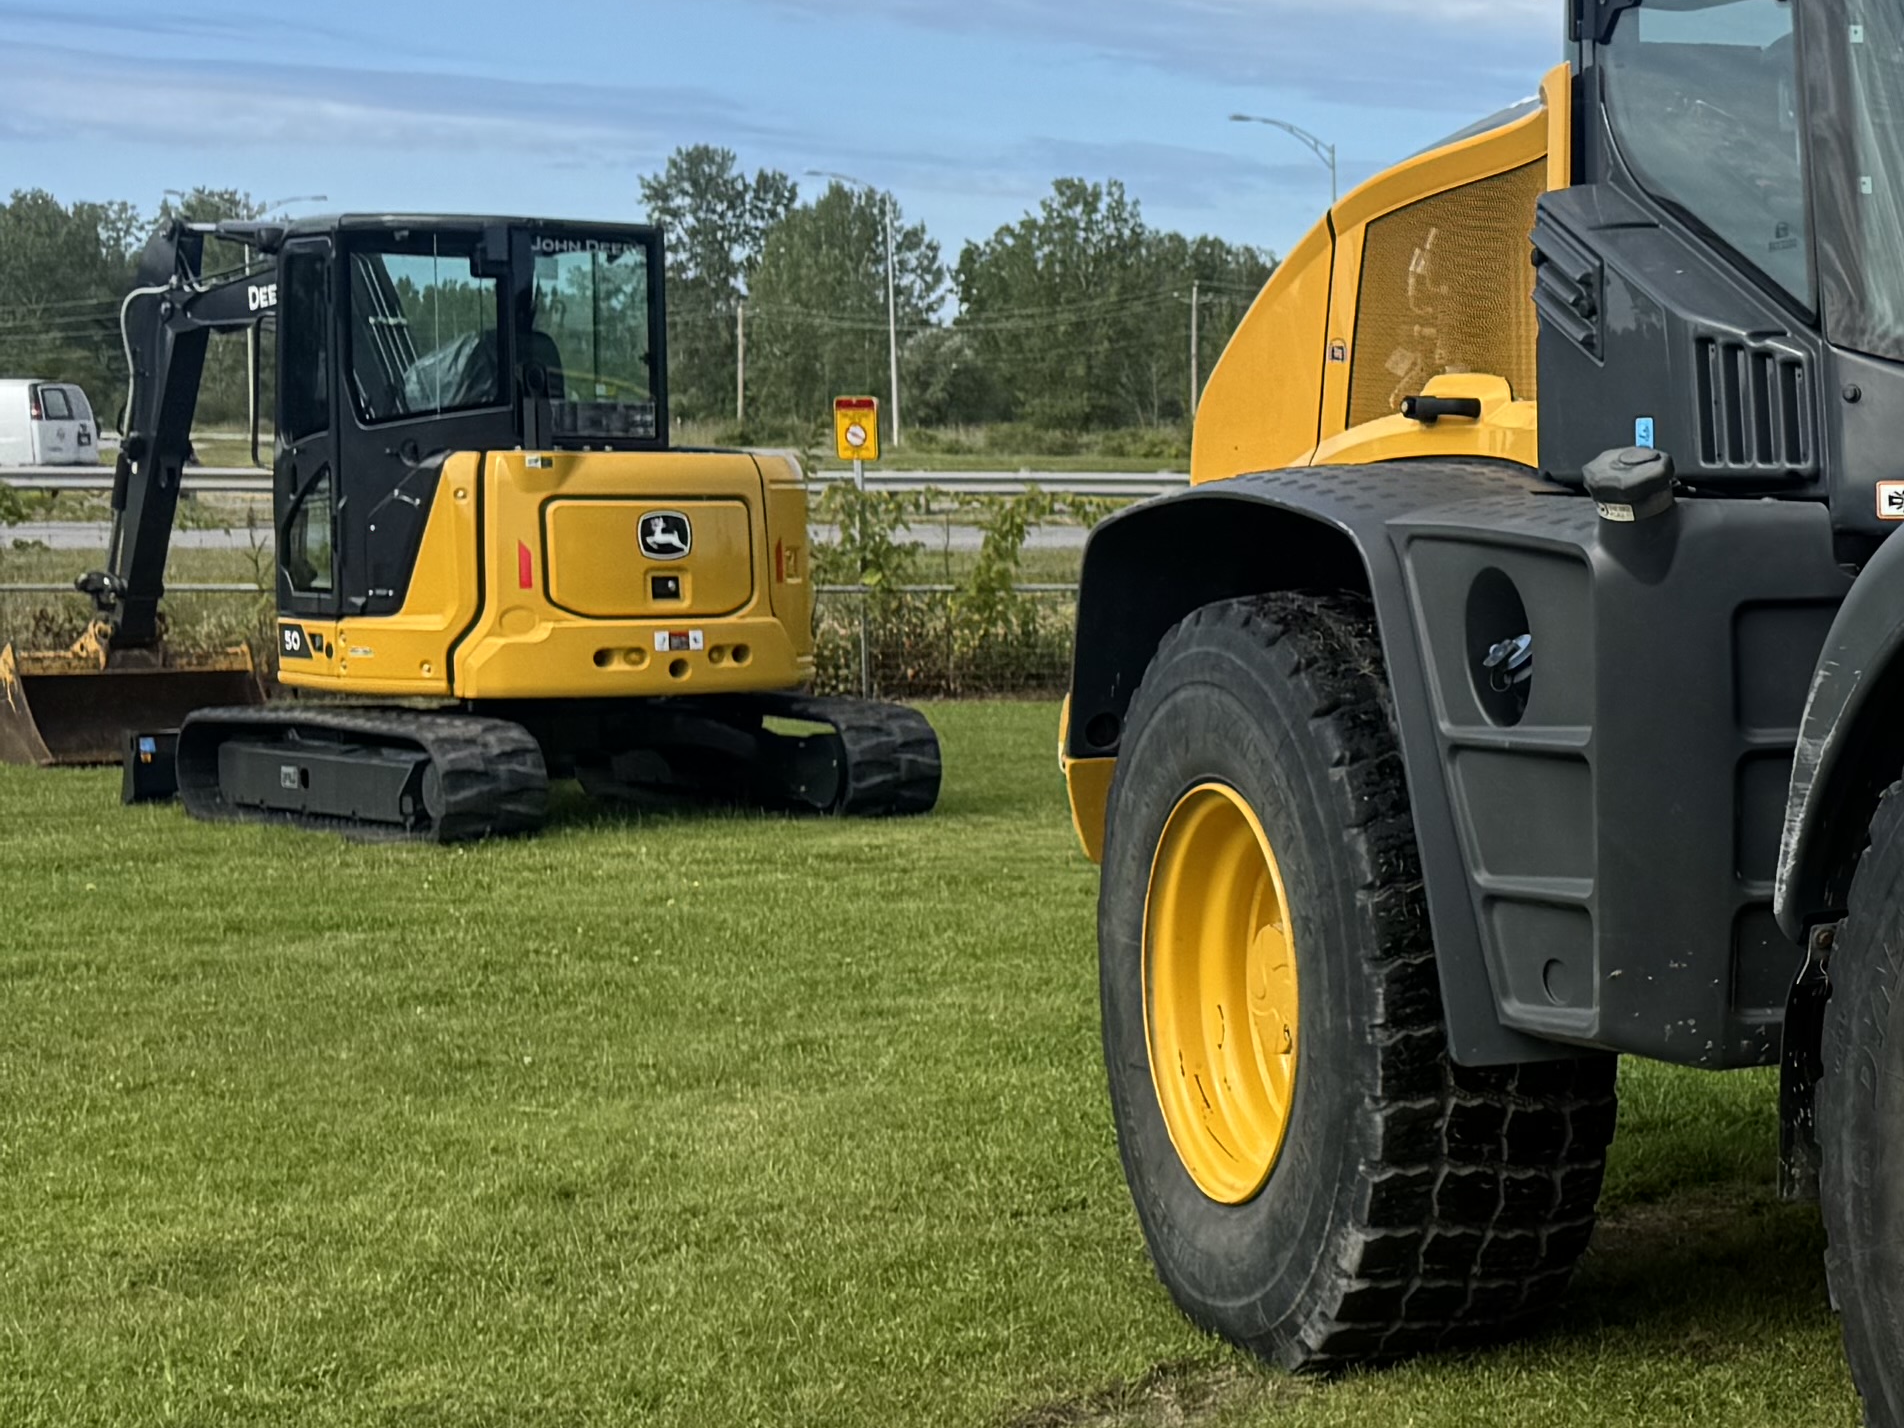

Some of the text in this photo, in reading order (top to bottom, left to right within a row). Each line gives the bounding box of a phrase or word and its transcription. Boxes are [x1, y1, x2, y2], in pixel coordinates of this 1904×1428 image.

[530, 235, 581, 253] JOHN
[247, 283, 278, 311] DEE
[284, 629, 301, 651] 50
